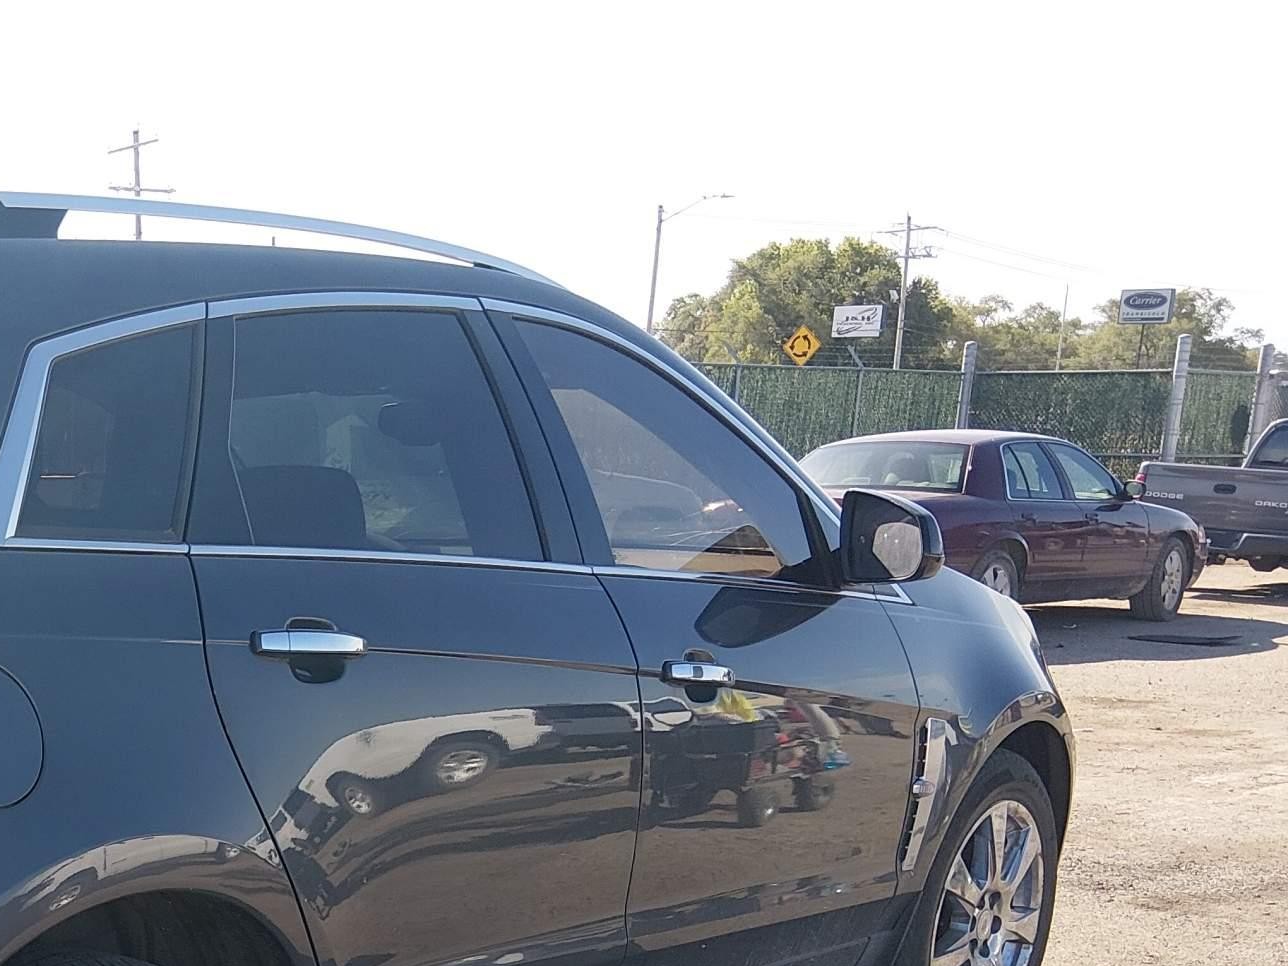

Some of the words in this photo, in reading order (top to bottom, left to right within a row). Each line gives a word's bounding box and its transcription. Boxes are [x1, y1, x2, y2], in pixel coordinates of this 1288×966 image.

[1129, 295, 1163, 305] Carrier
[1145, 490, 1184, 500] DODGE
[1254, 500, 1288, 509] DAKO
